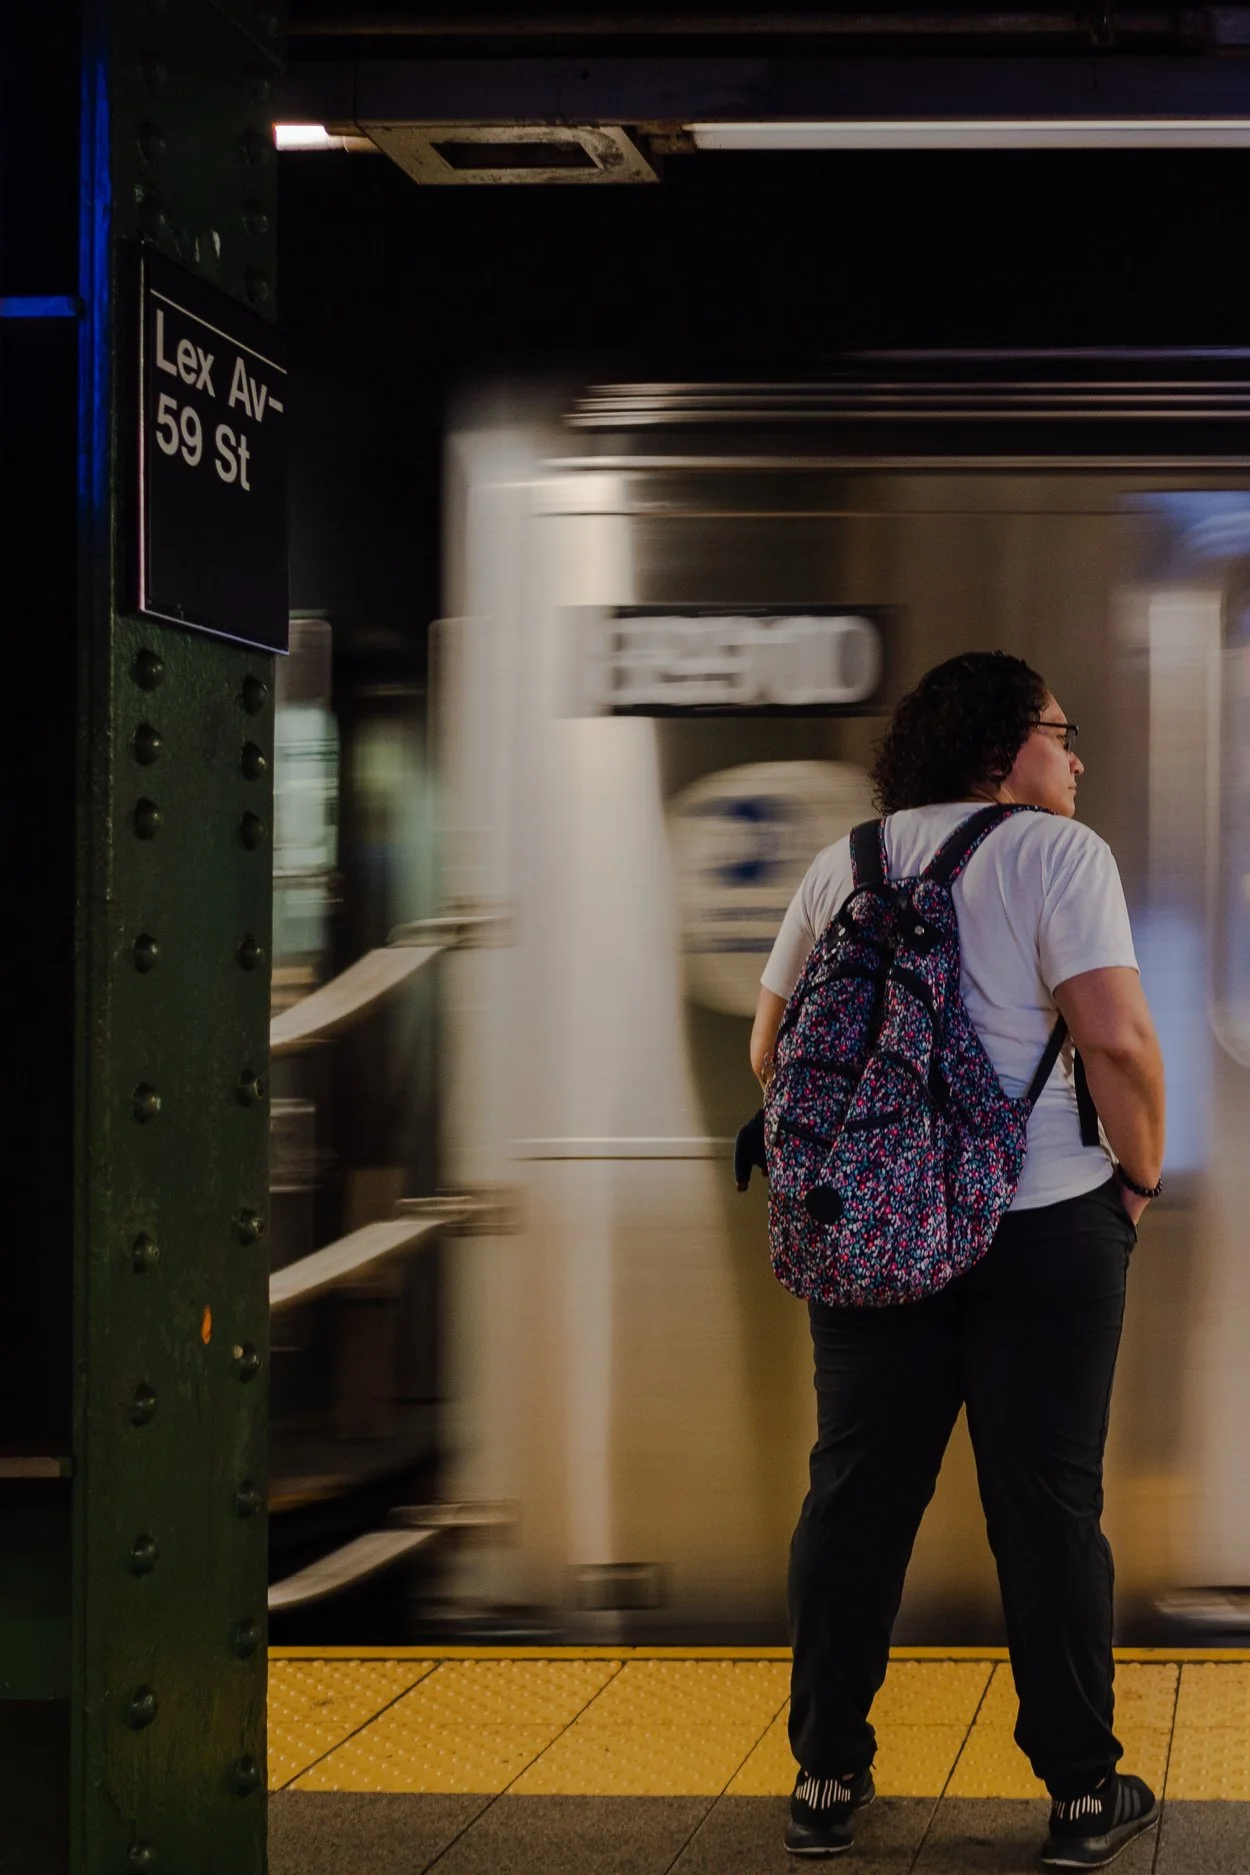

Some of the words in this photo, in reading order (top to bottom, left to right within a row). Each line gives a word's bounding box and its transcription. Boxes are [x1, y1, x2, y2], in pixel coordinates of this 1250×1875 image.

[156, 309, 216, 398] Lex
[228, 357, 284, 423] Av-
[156, 392, 203, 468] 59
[214, 423, 251, 491] St
